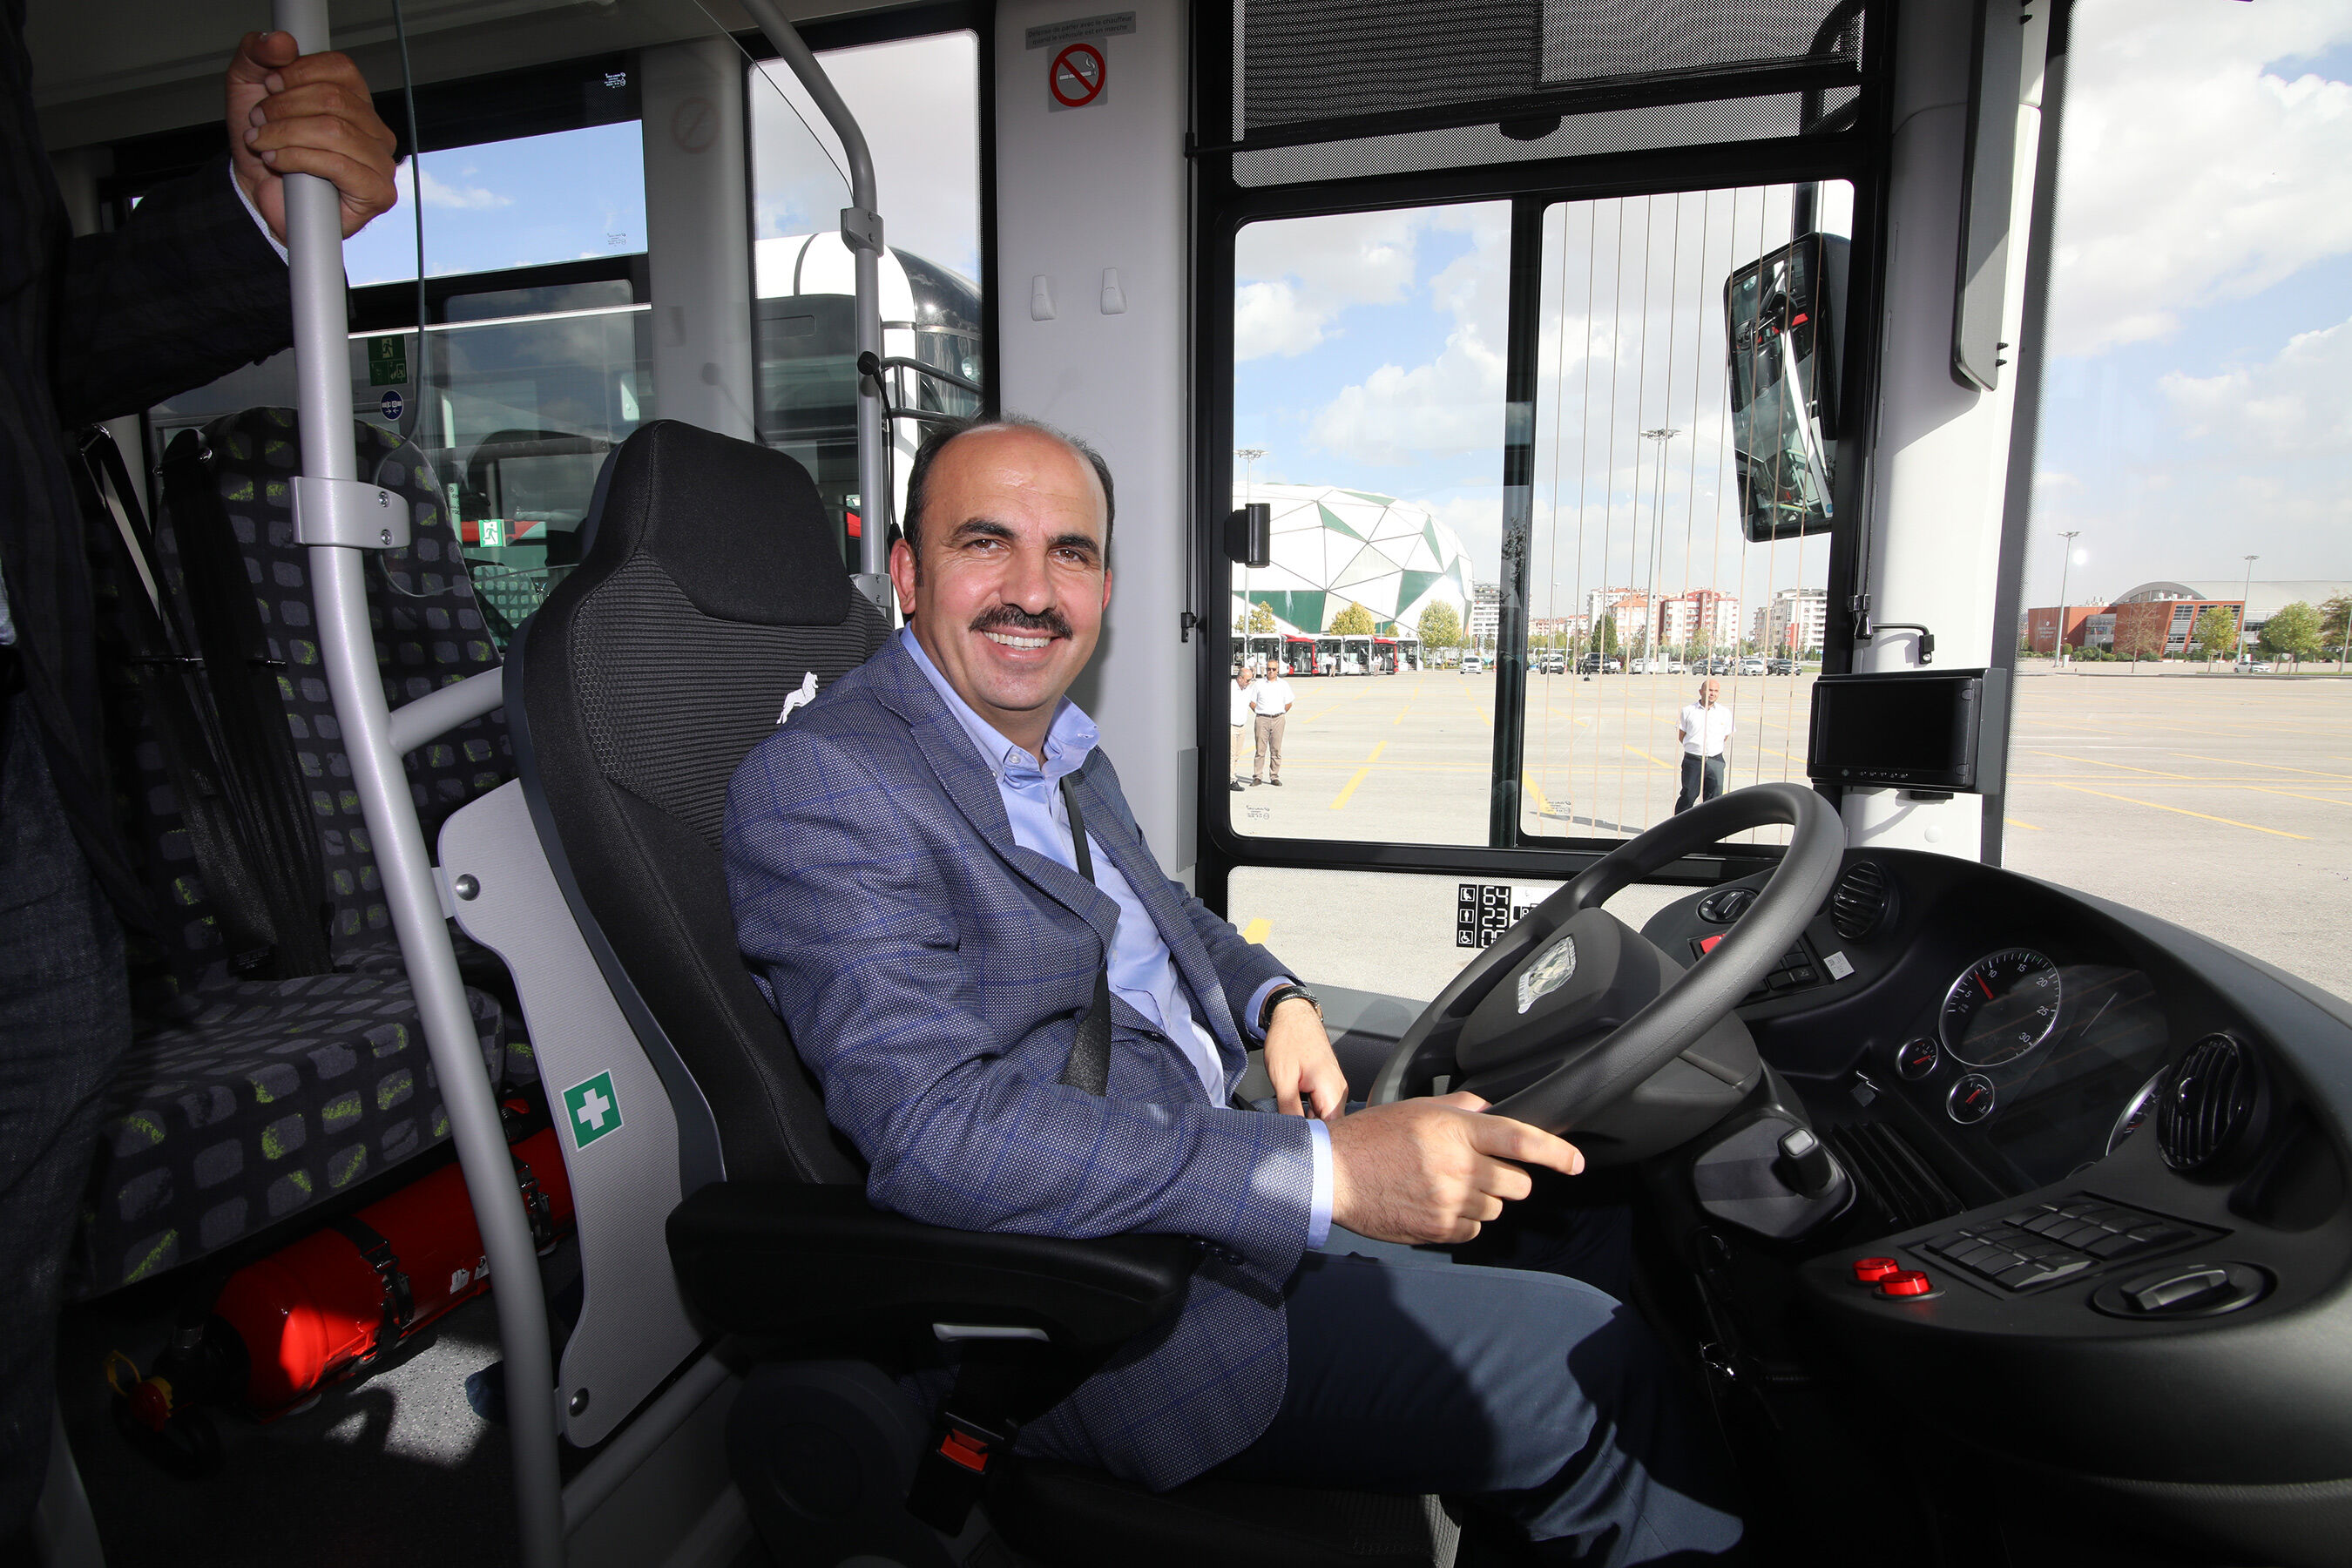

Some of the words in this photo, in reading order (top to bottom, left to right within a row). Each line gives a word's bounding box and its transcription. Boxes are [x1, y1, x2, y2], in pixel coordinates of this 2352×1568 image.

[1062, 24, 1078, 33] parler
[1103, 16, 1132, 24] chauffeur
[1483, 886, 1509, 905] 64
[1482, 907, 1507, 928] 23
[2017, 963, 2027, 973] 15
[1988, 970, 1997, 978] 10
[2036, 977, 2048, 988] 20
[2037, 1005, 2048, 1017] 25
[2018, 1032, 2031, 1043] 30
